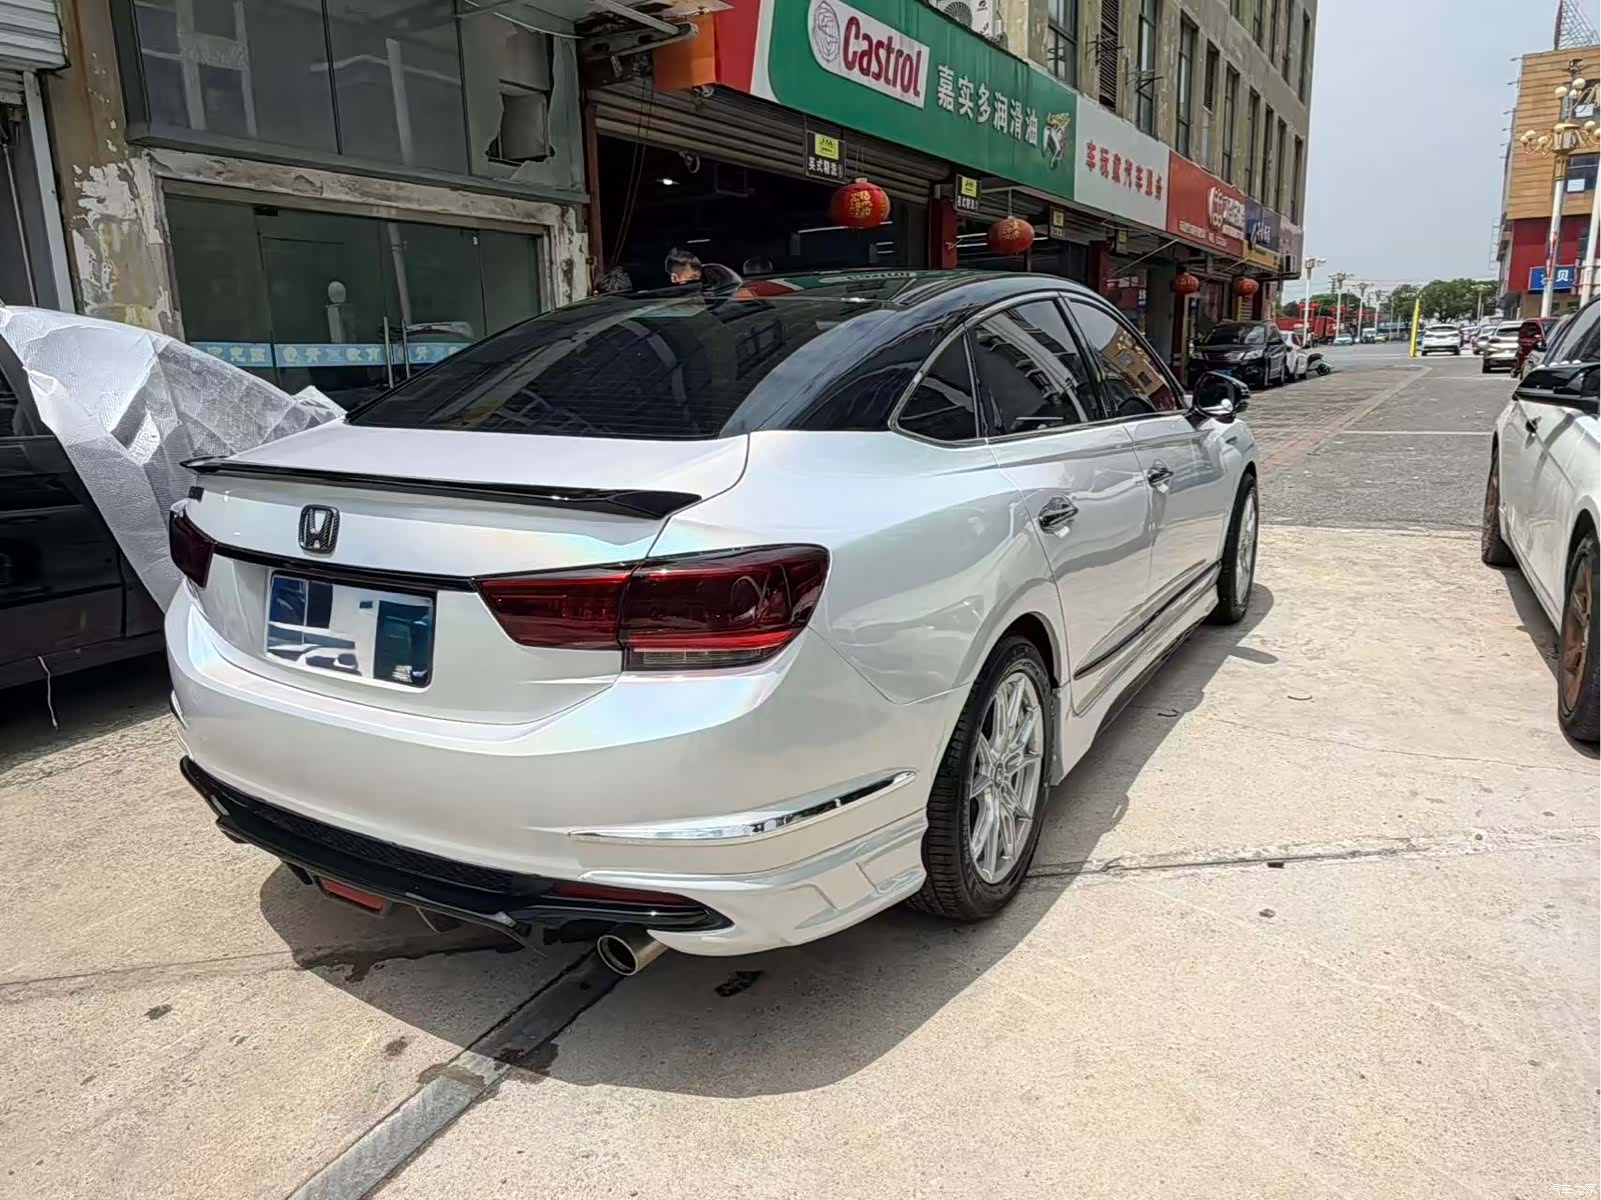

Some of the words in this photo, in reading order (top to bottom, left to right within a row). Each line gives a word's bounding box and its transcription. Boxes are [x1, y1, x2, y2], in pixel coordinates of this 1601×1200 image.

[843, 16, 922, 97] Castrol
[938, 65, 1038, 146] 嘉实多润滑油
